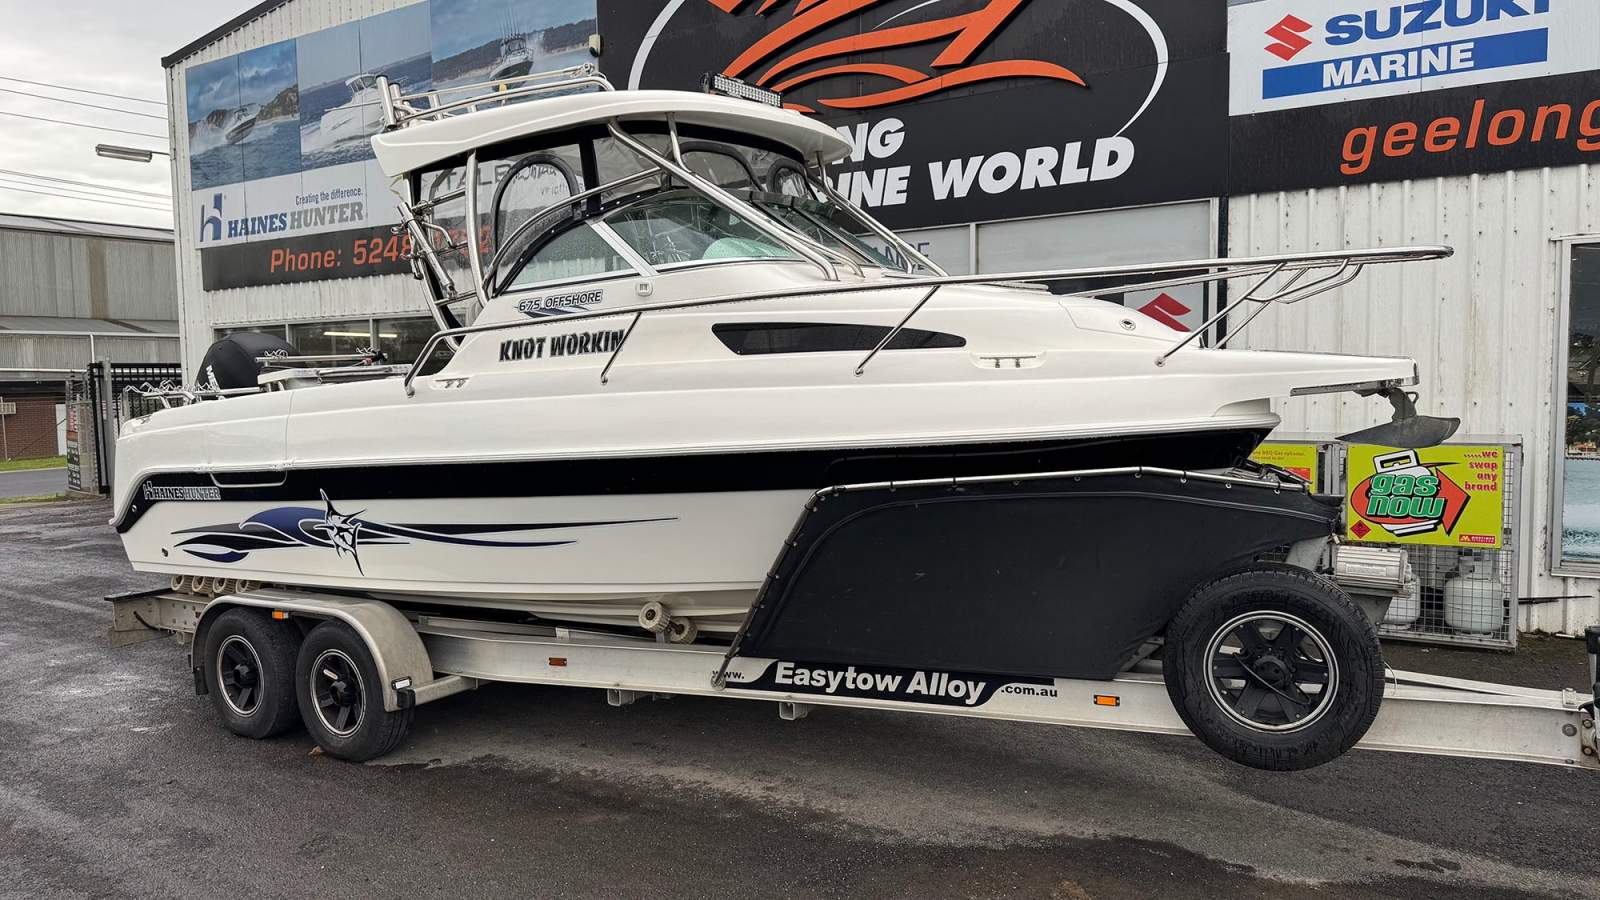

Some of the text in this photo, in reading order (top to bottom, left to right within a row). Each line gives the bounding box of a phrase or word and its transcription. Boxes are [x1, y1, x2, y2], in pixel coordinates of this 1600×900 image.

[1322, 42, 1474, 89] MARINE
[1340, 99, 1600, 175] geelong
[928, 136, 1135, 200] WORLD
[295, 192, 319, 206] Creating
[320, 190, 329, 201] the
[227, 201, 364, 239] HAINES HUNTER
[271, 247, 342, 273] Phone:
[519, 290, 602, 312] 675 OFFSHORE
[499, 336, 546, 362] KNOT
[1469, 462, 1498, 472] swap
[1477, 472, 1498, 482] any
[152, 487, 221, 500] HAINES HUNTER
[1370, 474, 1439, 496] gas
[1464, 481, 1498, 491] brand
[1367, 495, 1445, 517] now
[775, 661, 902, 693] Easytow
[905, 671, 987, 706] Alloy
[1001, 685, 1058, 698] .com.au
